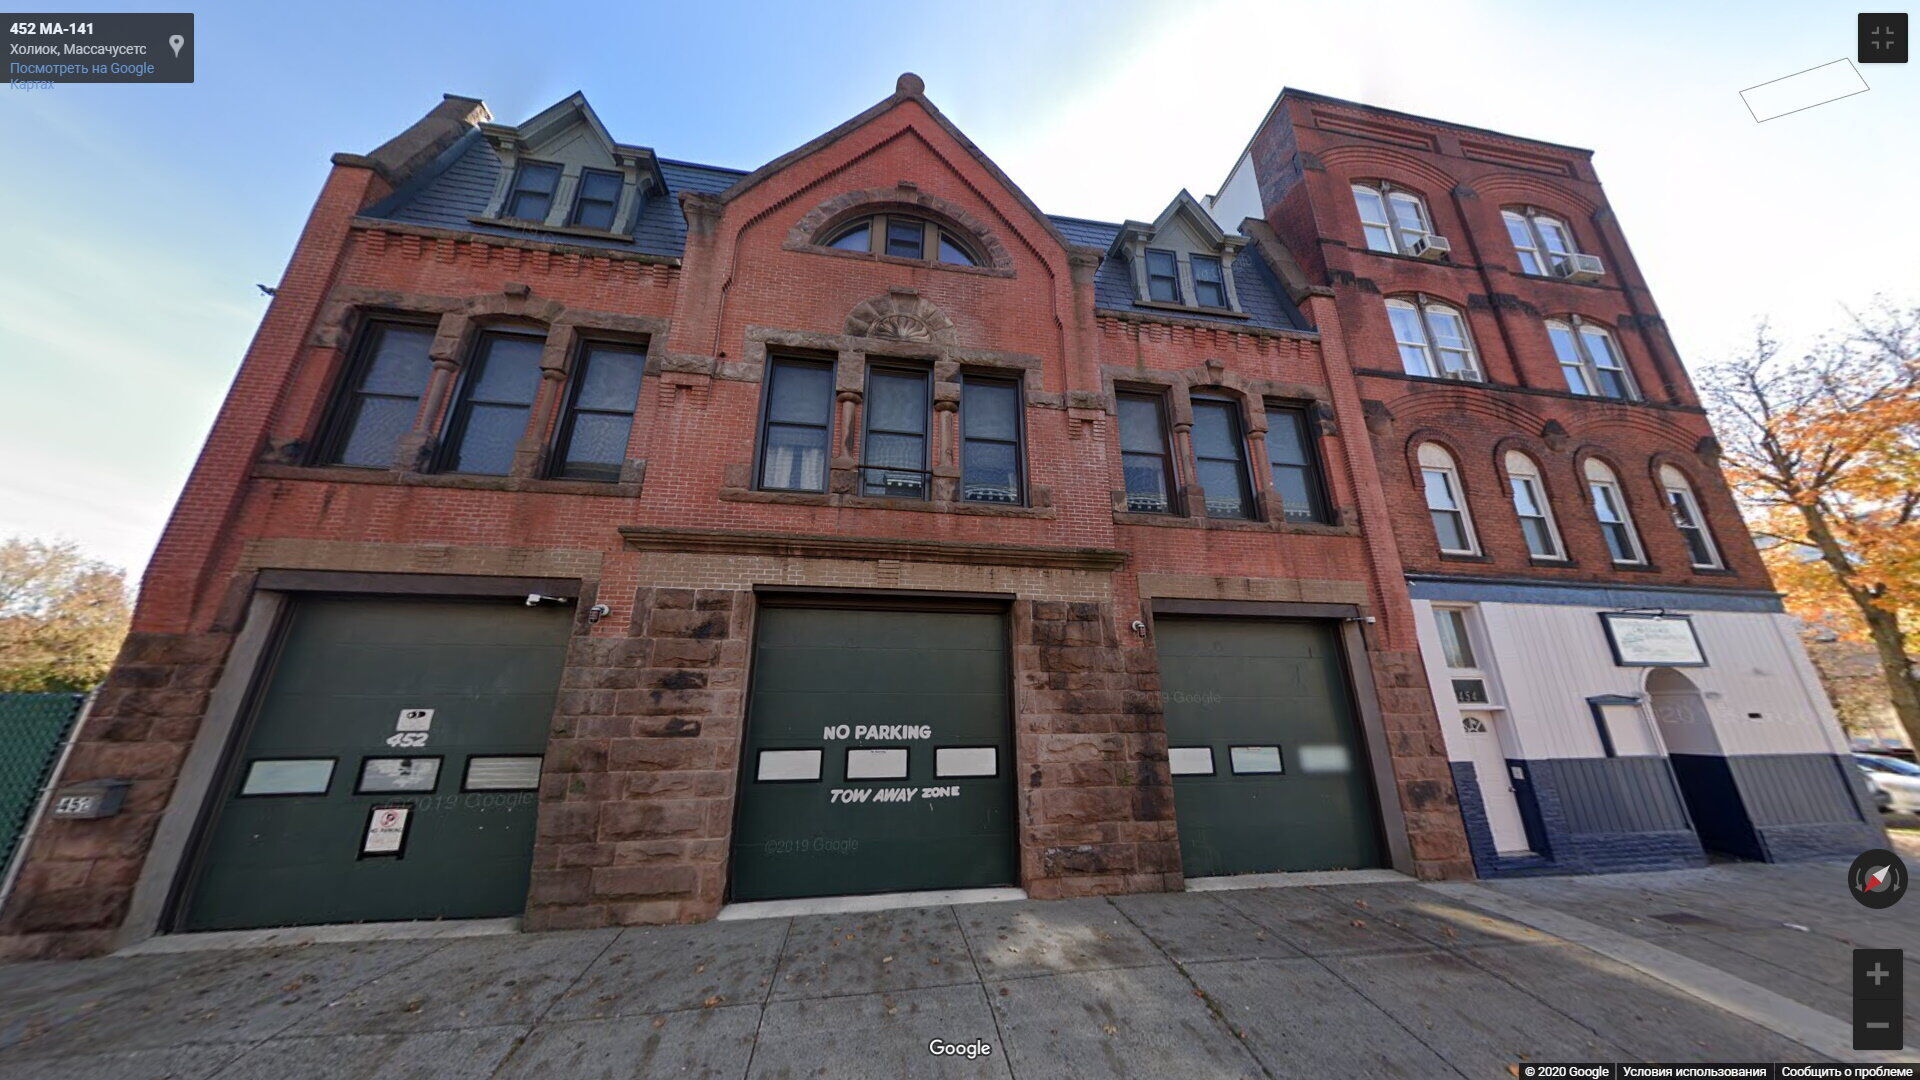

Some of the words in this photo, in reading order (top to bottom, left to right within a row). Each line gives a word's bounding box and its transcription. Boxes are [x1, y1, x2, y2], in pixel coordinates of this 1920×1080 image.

[386, 732, 429, 748] 452
[823, 724, 850, 740] NO
[854, 724, 932, 740] PARKING
[830, 788, 872, 803] TOW
[872, 787, 918, 802] AWAY
[921, 785, 960, 799] ZONE
